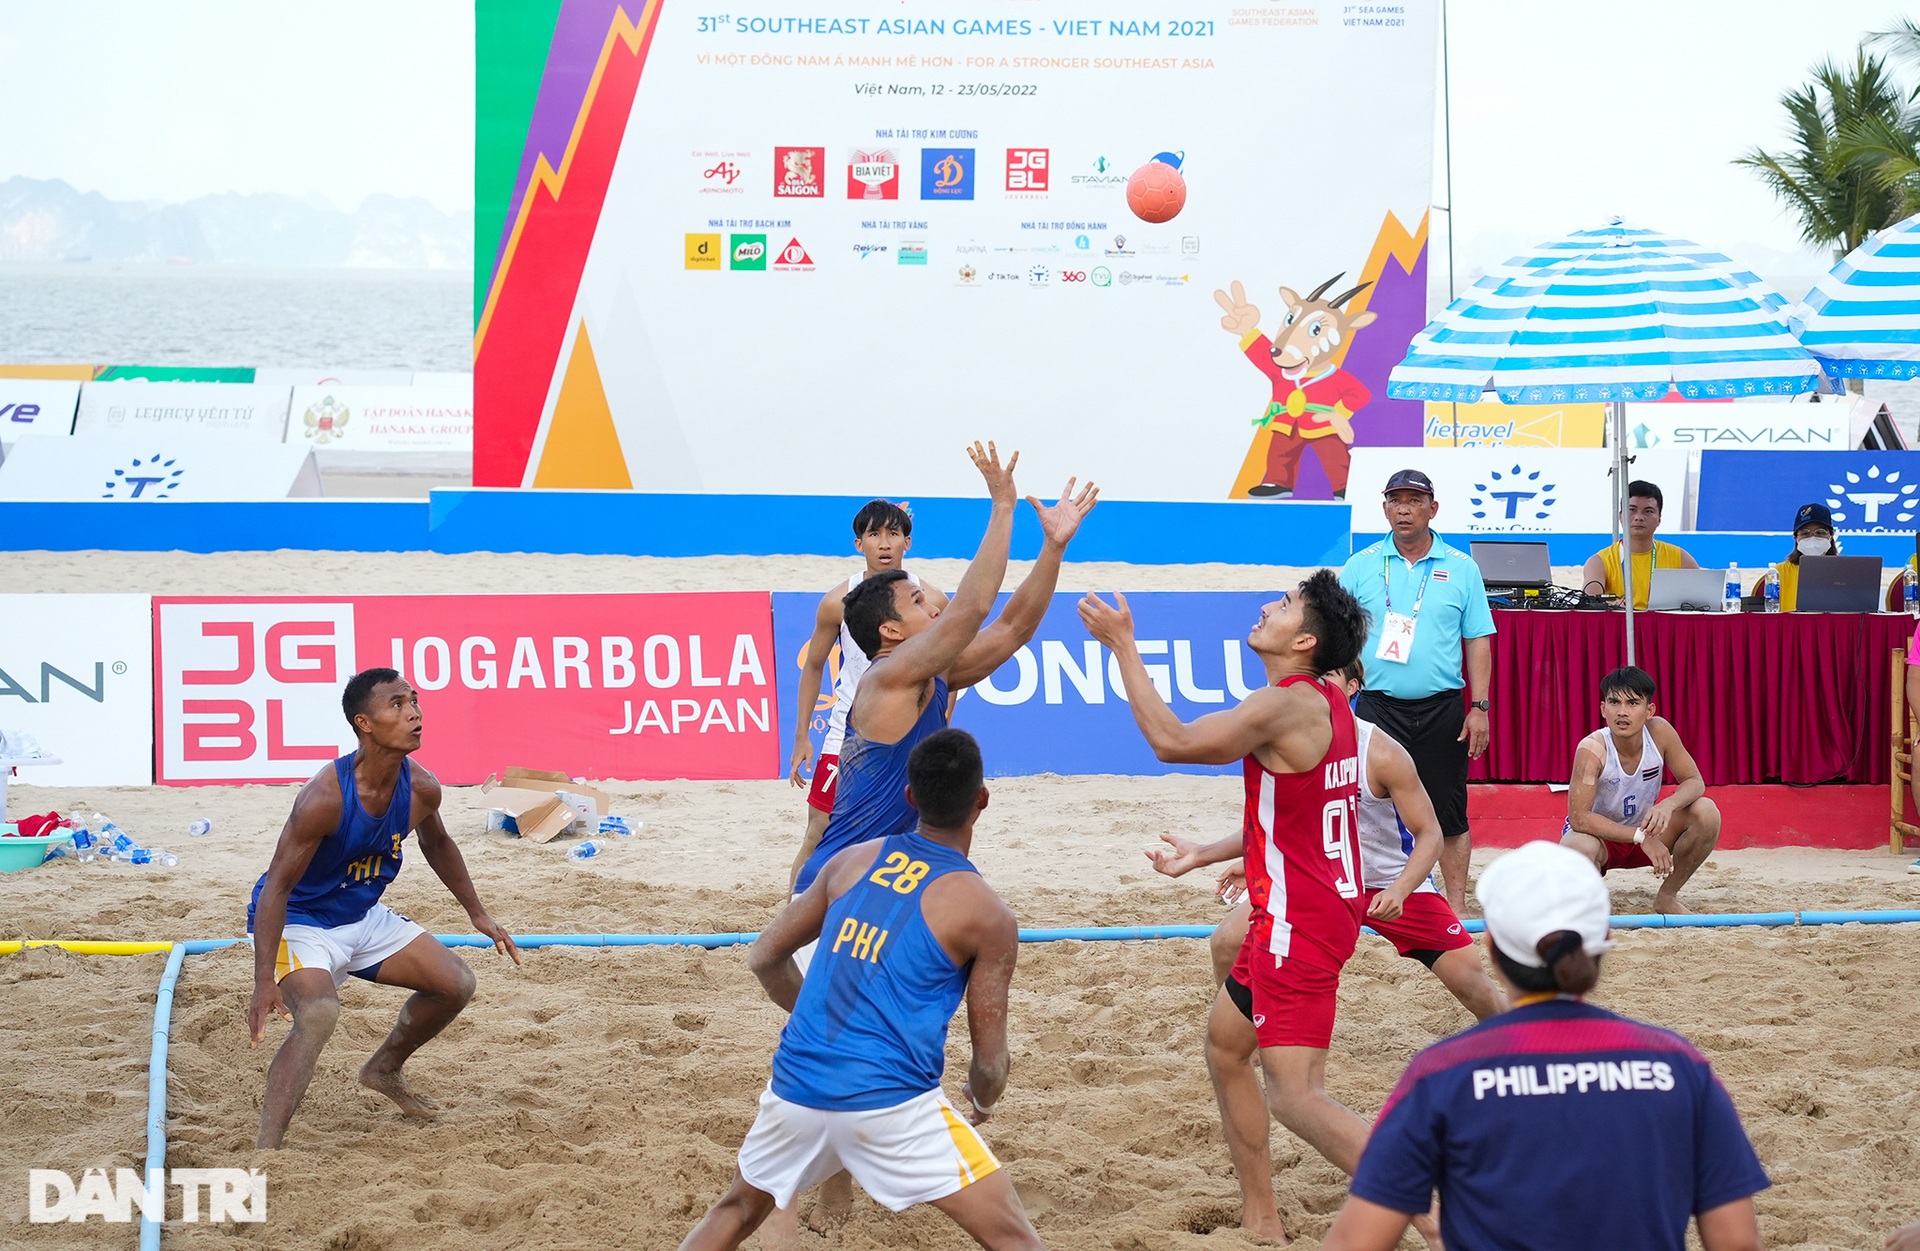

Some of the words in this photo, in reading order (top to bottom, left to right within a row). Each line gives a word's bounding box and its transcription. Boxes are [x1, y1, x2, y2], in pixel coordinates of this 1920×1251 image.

[1232, 8, 1286, 17] SOUTHEAST
[1288, 9, 1315, 17] ASIAN
[1358, 6, 1374, 14] SEA
[1376, 6, 1405, 14] GAMES
[736, 17, 871, 34] SOUTHEAST
[876, 19, 945, 35] ASIAN
[953, 19, 1032, 36] GAMES
[1053, 20, 1102, 36] VIET
[1109, 21, 1160, 36] NAM
[1168, 20, 1215, 37] 2021
[1228, 18, 1260, 26] GAMES
[1262, 18, 1319, 26] FEDERATION
[1343, 18, 1361, 27] VIET
[1363, 19, 1383, 27] NAM
[1385, 18, 1405, 27] 2021
[714, 53, 747, 68] MỘT
[750, 53, 793, 66] ĐÔNG
[797, 55, 830, 66] NAM
[834, 53, 844, 66] Á
[848, 56, 891, 68] MẠNH
[966, 57, 995, 68] FOR
[999, 57, 1009, 68] A
[1013, 57, 1089, 69] STRONGER
[1093, 58, 1178, 69] SOUTHEAST
[1182, 58, 1215, 69] ASIA
[854, 83, 883, 97] Việt
[887, 84, 926, 97] Nam,
[931, 84, 944, 95] 12
[957, 83, 1038, 96] 23/05/2022
[930, 129, 947, 139] KIM
[855, 166, 871, 176] BIA
[776, 220, 792, 228] KIM
[1062, 271, 1087, 283] 360
[1673, 427, 1832, 443] STAVIAN
[1383, 640, 1400, 660] A
[390, 634, 767, 691] JOGARBOLA
[609, 697, 771, 735] JAPAN
[826, 762, 839, 793] 7
[1623, 794, 1636, 818] 6
[869, 851, 931, 895] 28
[832, 917, 889, 964] PHI
[1472, 1060, 1675, 1100] PHILIPPINES
